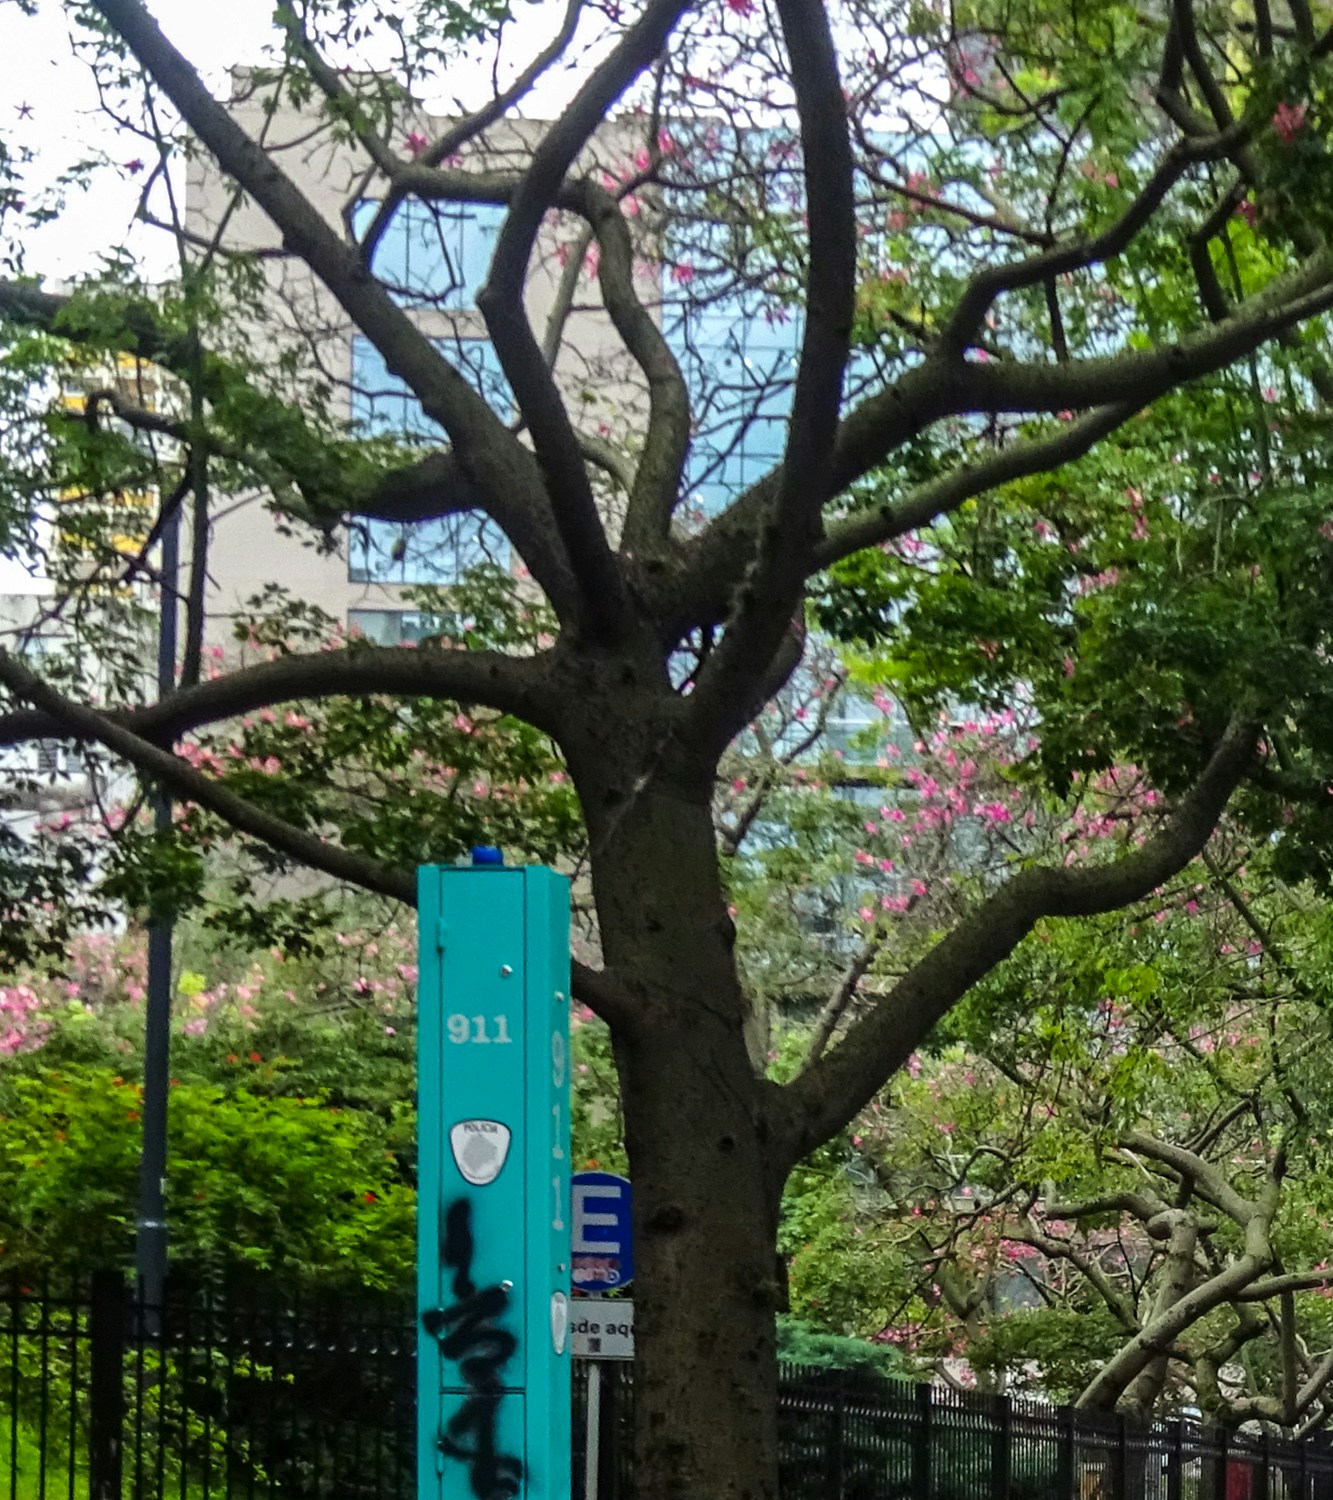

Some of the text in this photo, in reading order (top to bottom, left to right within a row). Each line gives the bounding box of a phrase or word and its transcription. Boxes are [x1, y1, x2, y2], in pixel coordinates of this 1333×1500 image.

[448, 1014, 512, 1044] 911
[571, 1185, 621, 1254] E
[571, 1319, 600, 1334] sde
